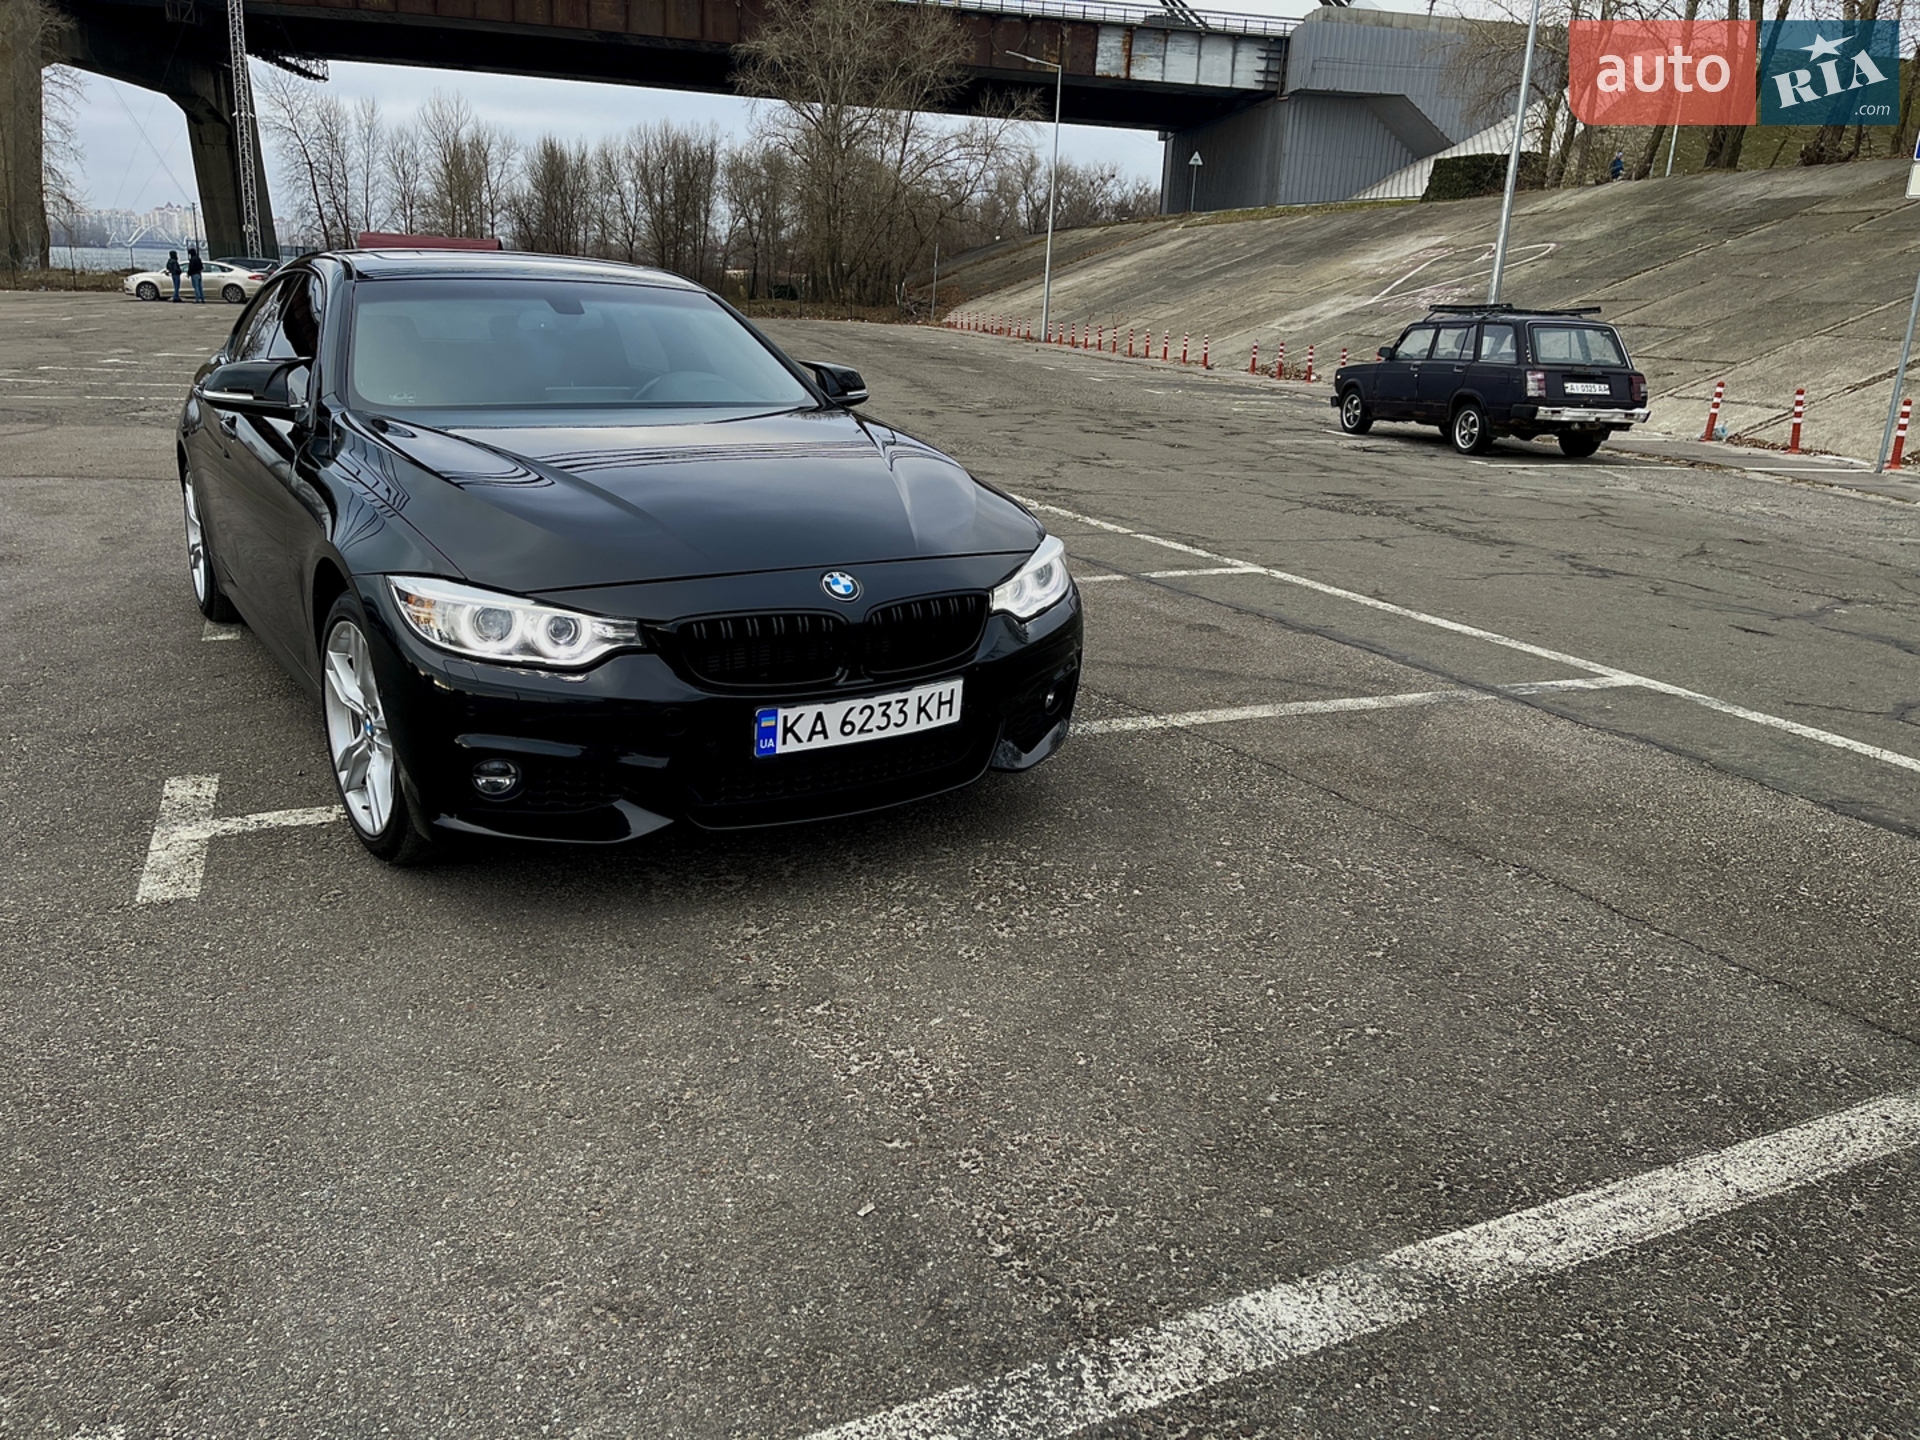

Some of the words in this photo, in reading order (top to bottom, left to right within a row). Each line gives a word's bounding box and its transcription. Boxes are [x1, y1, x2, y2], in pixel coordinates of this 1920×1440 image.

[782, 711, 829, 746] KA
[839, 698, 909, 737] 6233
[916, 688, 955, 725] KH
[760, 738, 775, 749] UA
